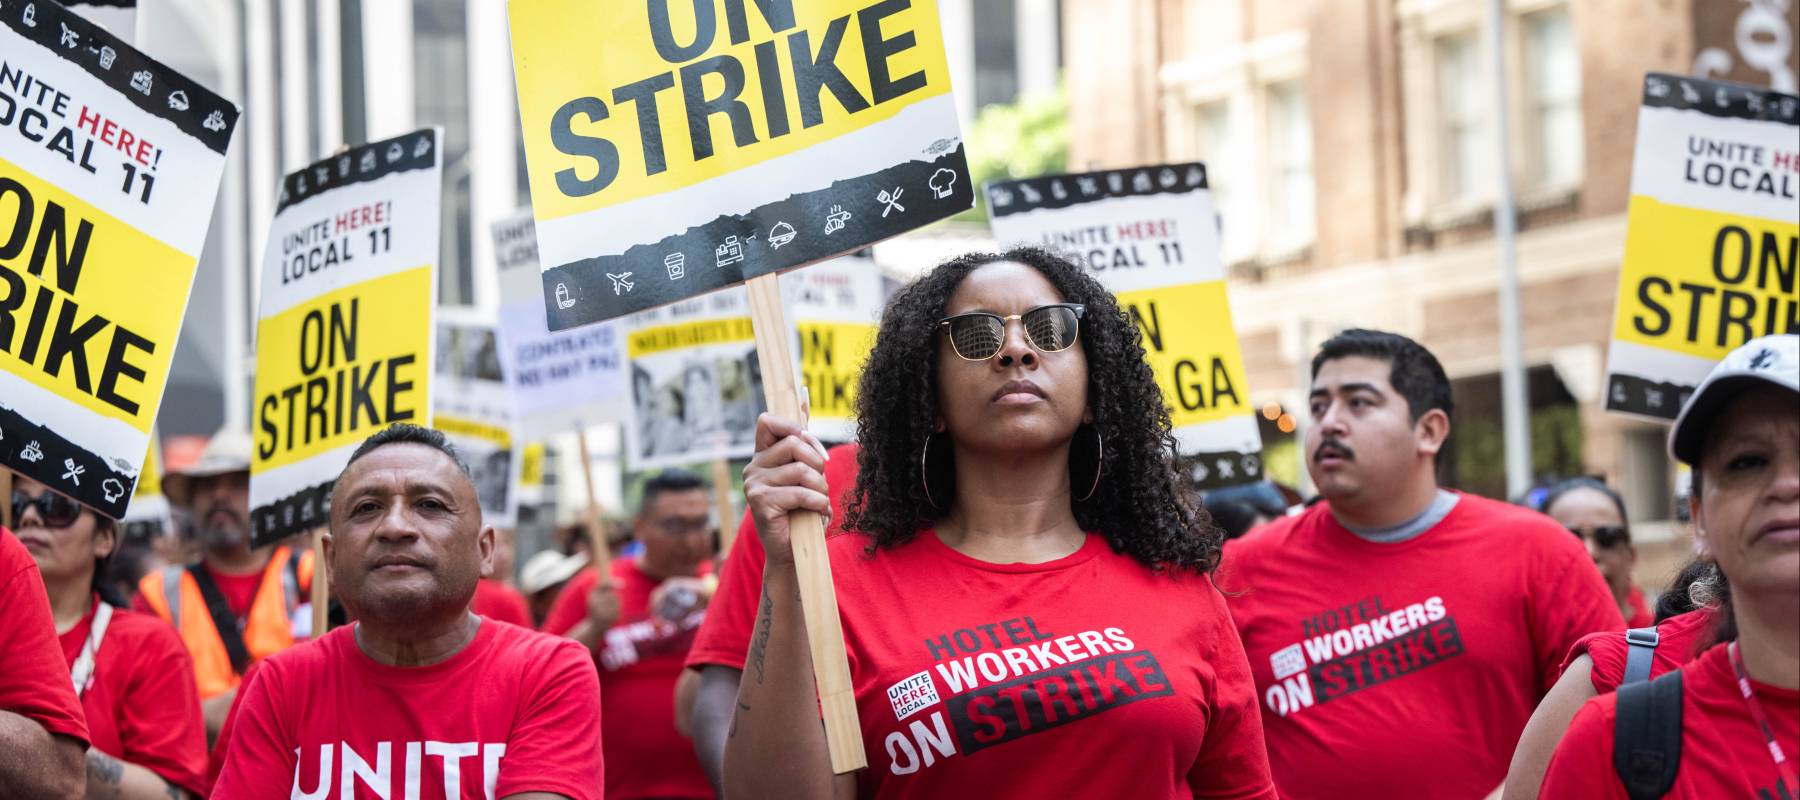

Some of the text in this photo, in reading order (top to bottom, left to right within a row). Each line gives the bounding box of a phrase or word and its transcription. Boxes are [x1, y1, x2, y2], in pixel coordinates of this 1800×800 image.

[0, 60, 163, 171] NITE HERE!
[549, 0, 928, 199] STRIKE
[0, 90, 155, 205] OCAL 11
[1685, 158, 1795, 199] LOCAL
[1689, 136, 1764, 166] UNITE
[0, 176, 94, 296] ON
[281, 226, 392, 286] LOCAL 11
[283, 200, 392, 256] UNITE HERE!
[1159, 241, 1183, 265] 11
[1712, 224, 1799, 294] ON
[300, 297, 360, 377] ON
[258, 353, 416, 461] STRIKE
[1174, 357, 1241, 412] GA
[924, 615, 1054, 661] HOTEL
[1301, 595, 1391, 637] HOTEL
[1303, 596, 1447, 664] WORKERS
[889, 673, 930, 699] UNITE
[935, 627, 1135, 694] WORKERS
[1266, 672, 1315, 717] ON
[1320, 622, 1457, 696] STRIKE
[884, 656, 1165, 775] ON STRIKE
[893, 683, 933, 710] HERE!
[897, 693, 937, 718] LOCAL 11
